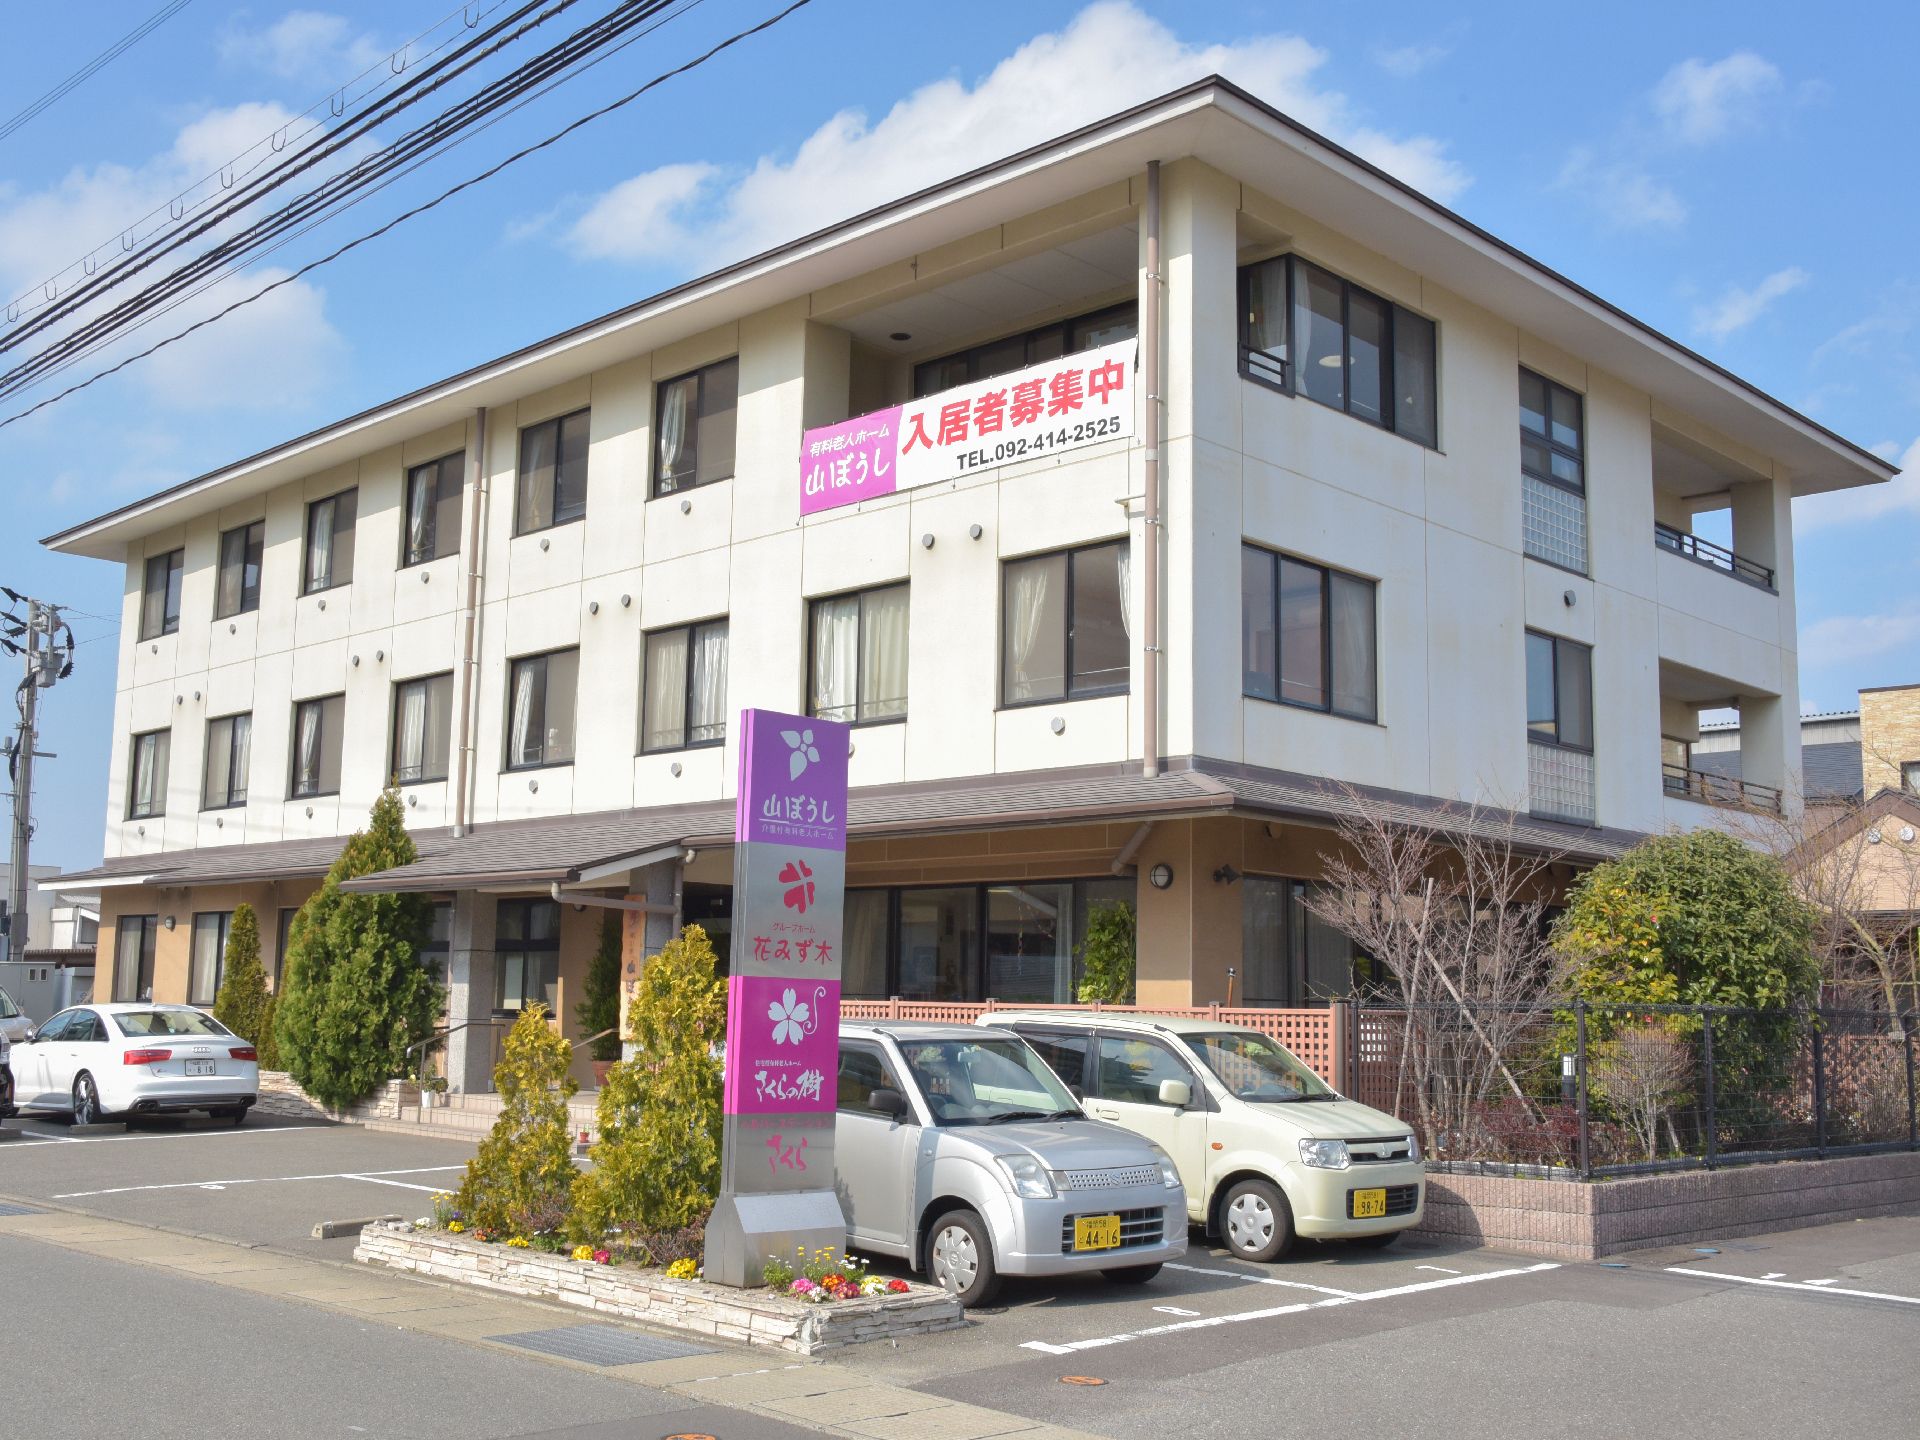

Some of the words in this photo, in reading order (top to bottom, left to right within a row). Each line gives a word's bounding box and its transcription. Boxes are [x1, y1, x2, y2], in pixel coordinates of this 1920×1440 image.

[902, 359, 1125, 455] 入居者募集中
[810, 424, 889, 458] 有料老人ホーム
[957, 416, 1121, 470] TEL.092-414-2525
[806, 448, 890, 495] 山ぼうし
[763, 794, 835, 823] 山ぼうし
[754, 936, 832, 965] 花みず木
[766, 1134, 808, 1176] さくら
[1086, 1229, 1118, 1247] 44-16
